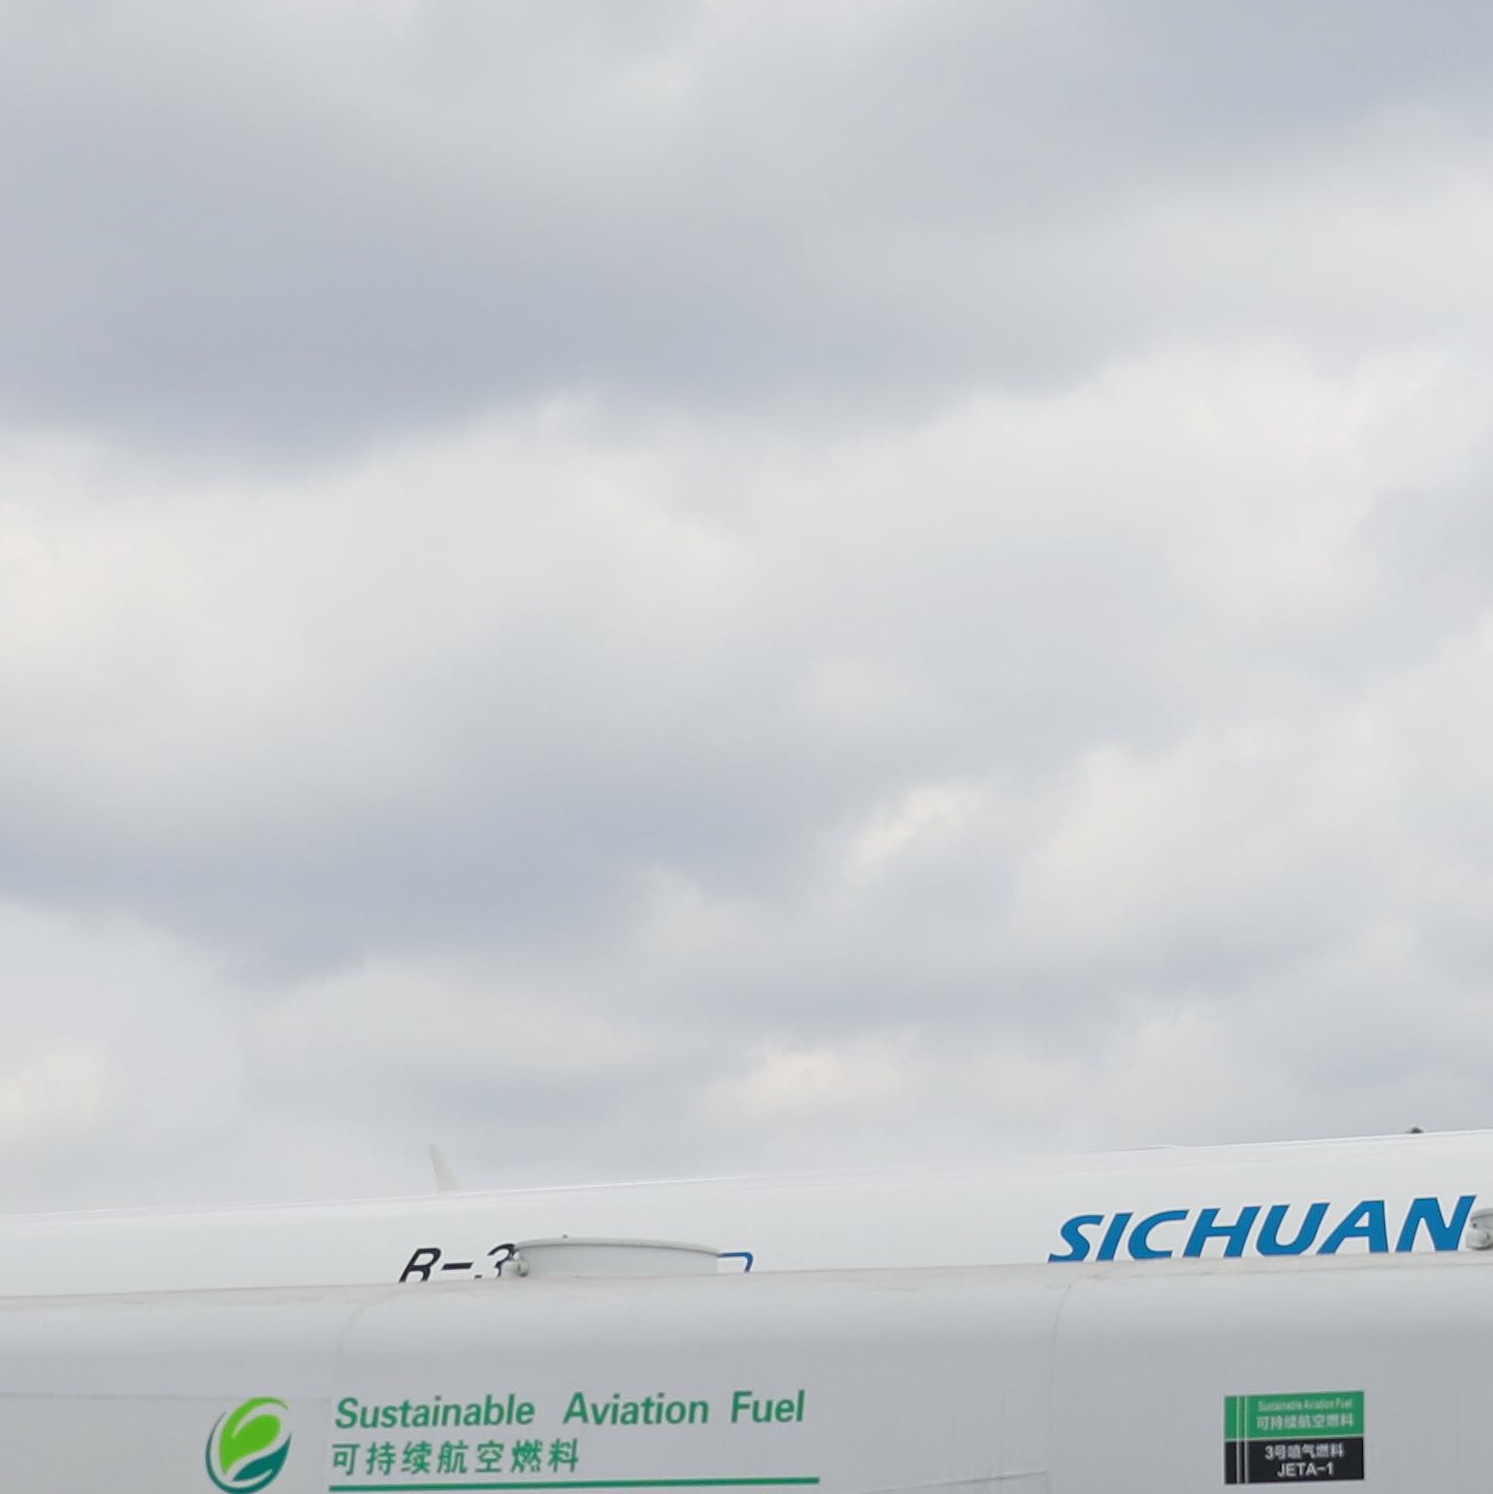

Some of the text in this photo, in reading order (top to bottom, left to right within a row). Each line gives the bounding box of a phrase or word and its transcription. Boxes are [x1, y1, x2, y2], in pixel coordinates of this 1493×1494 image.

[1047, 1195, 1477, 1263] SICHUAN
[335, 1390, 806, 1429] Sustainable Aviation Fuel
[332, 1438, 578, 1475] 可持续航空燃料
[1277, 1461, 1334, 1477] JETA-1
